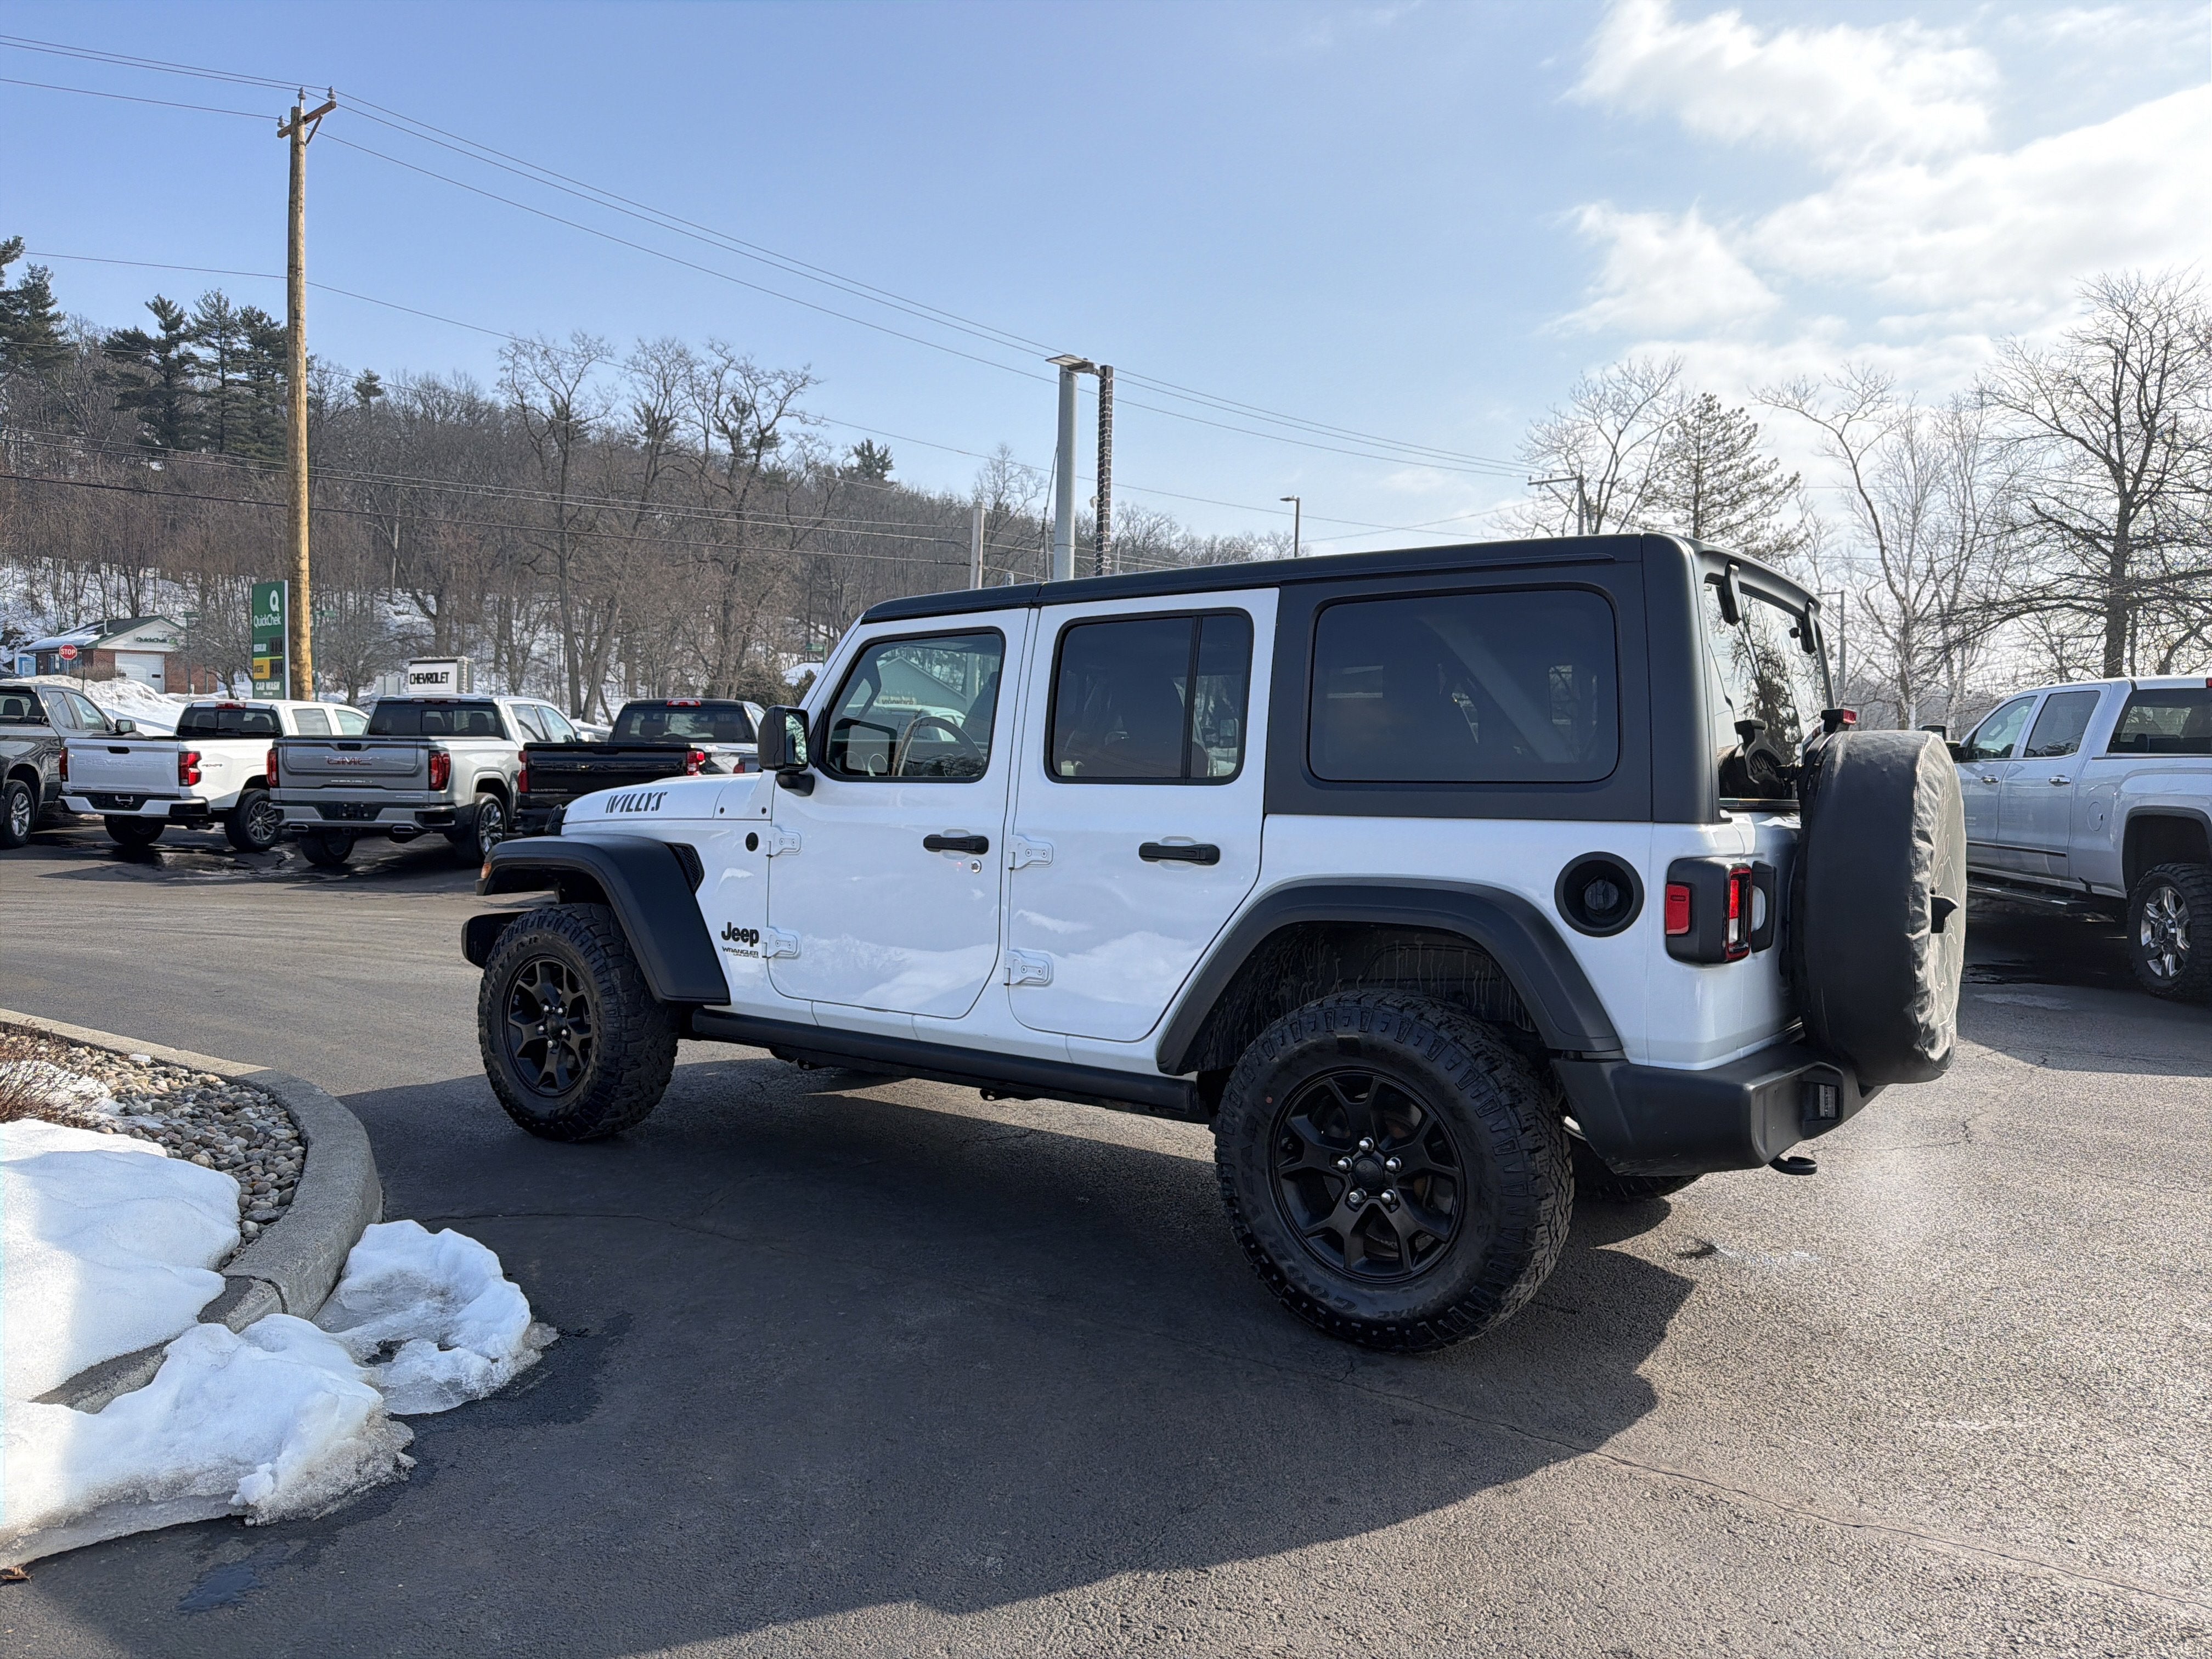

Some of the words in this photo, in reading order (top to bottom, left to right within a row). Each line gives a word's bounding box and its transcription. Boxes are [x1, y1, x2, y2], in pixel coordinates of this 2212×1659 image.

[253, 613, 281, 629] QuickChek
[410, 672, 449, 685] CHEVROLET
[256, 682, 264, 690] CAR
[266, 681, 280, 691] WASH
[327, 757, 372, 765] GMC
[606, 792, 668, 813] WILLYS
[721, 922, 759, 947] Jeep
[722, 946, 759, 955] WRANGLER
